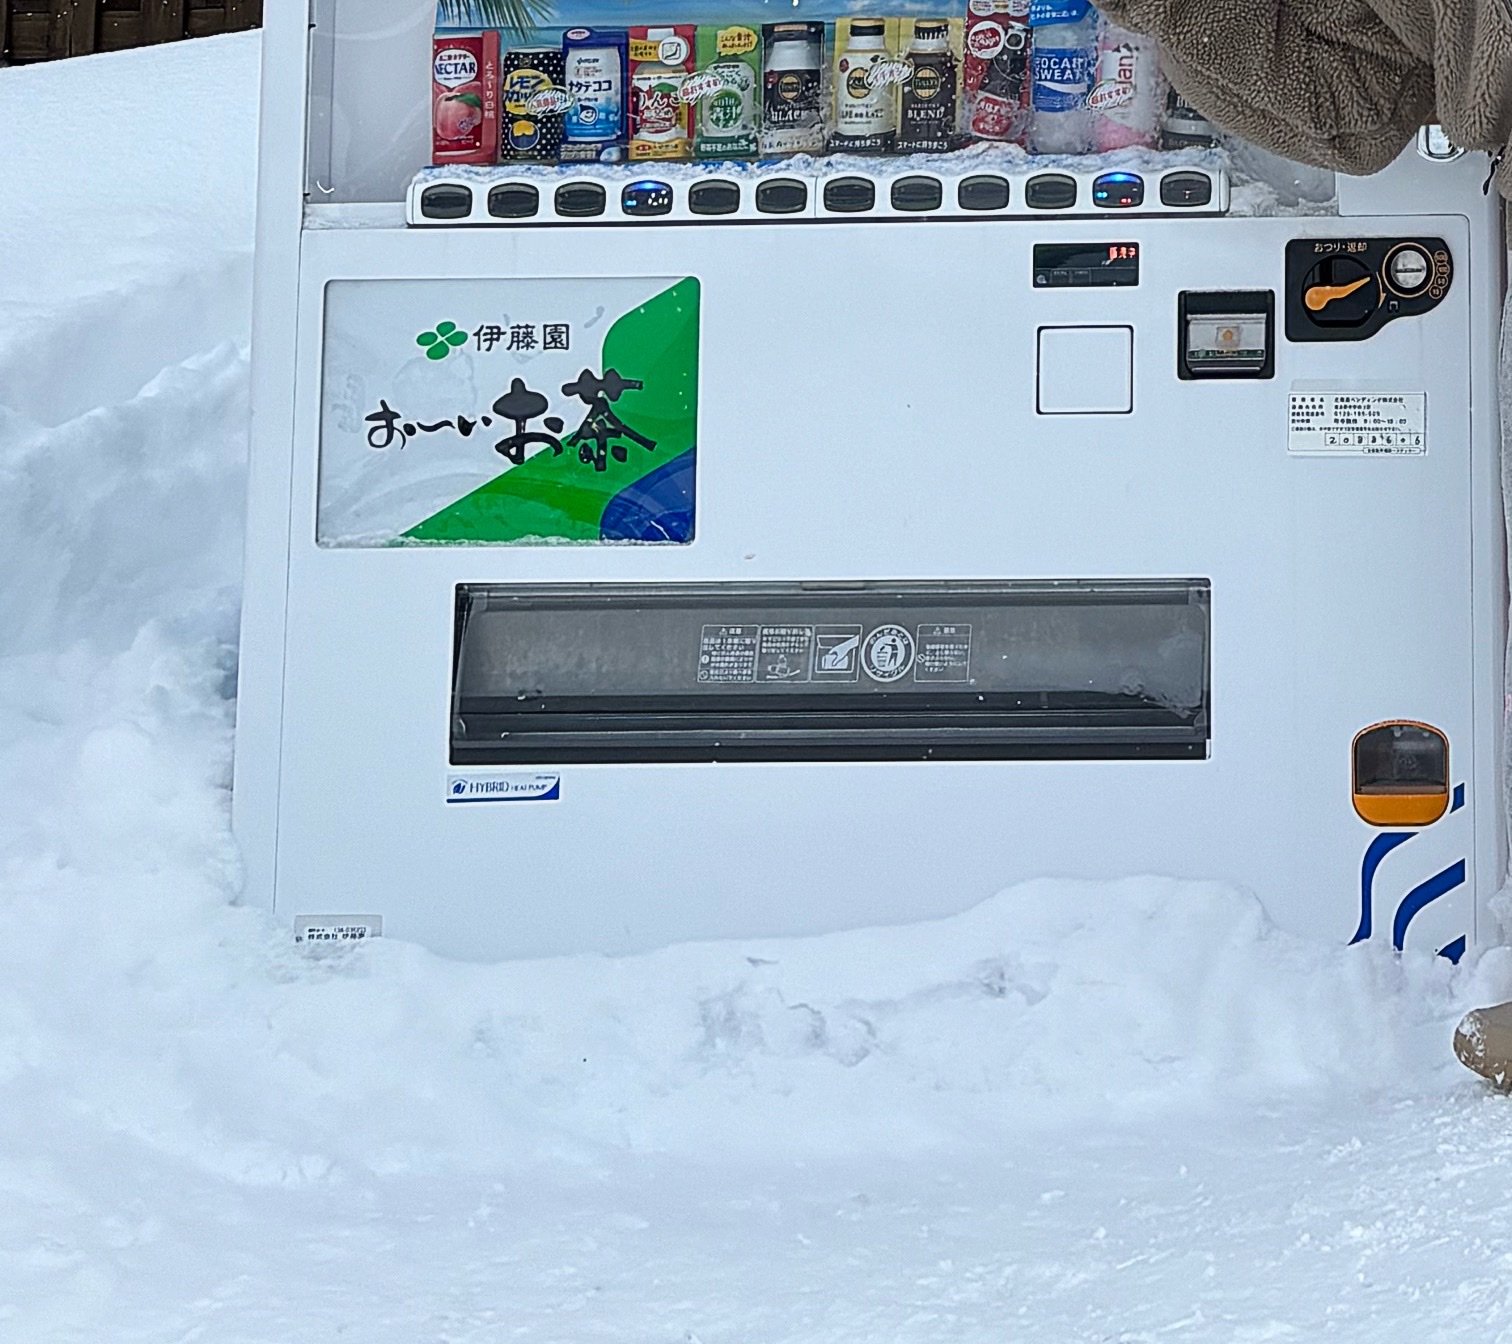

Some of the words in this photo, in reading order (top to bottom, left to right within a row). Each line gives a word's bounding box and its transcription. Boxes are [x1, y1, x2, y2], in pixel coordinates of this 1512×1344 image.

[1314, 242, 1368, 252] おつり・返却
[472, 323, 571, 352] 伊藤園
[469, 781, 509, 794] HYBRID
